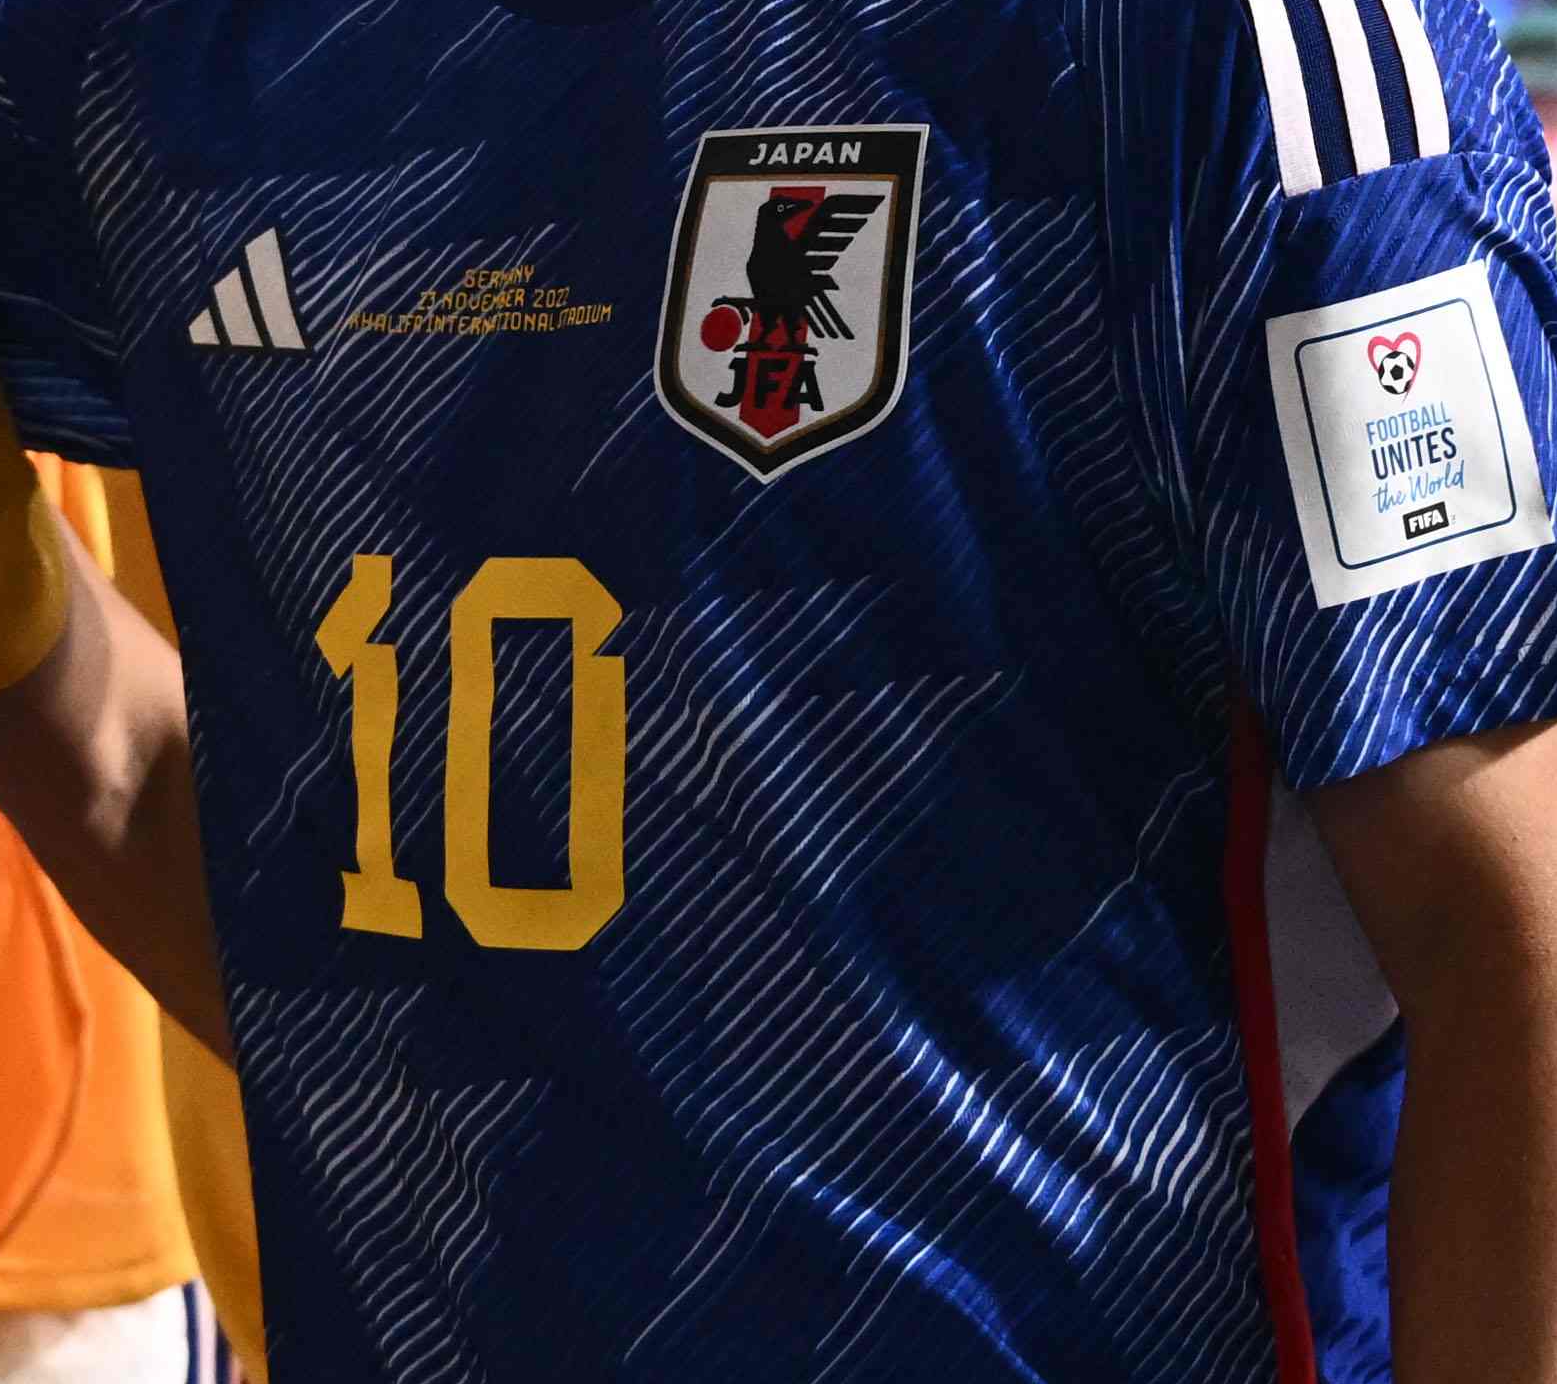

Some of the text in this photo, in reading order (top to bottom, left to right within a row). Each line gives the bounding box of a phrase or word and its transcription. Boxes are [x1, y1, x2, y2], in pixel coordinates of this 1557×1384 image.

[749, 139, 865, 168] JAPAN
[713, 358, 825, 414] JFA
[1366, 401, 1452, 445] FOOTBALL
[1371, 428, 1458, 480] UNITES
[1372, 460, 1465, 514] the World
[1407, 505, 1445, 535] FIFA
[315, 552, 626, 951] 10
